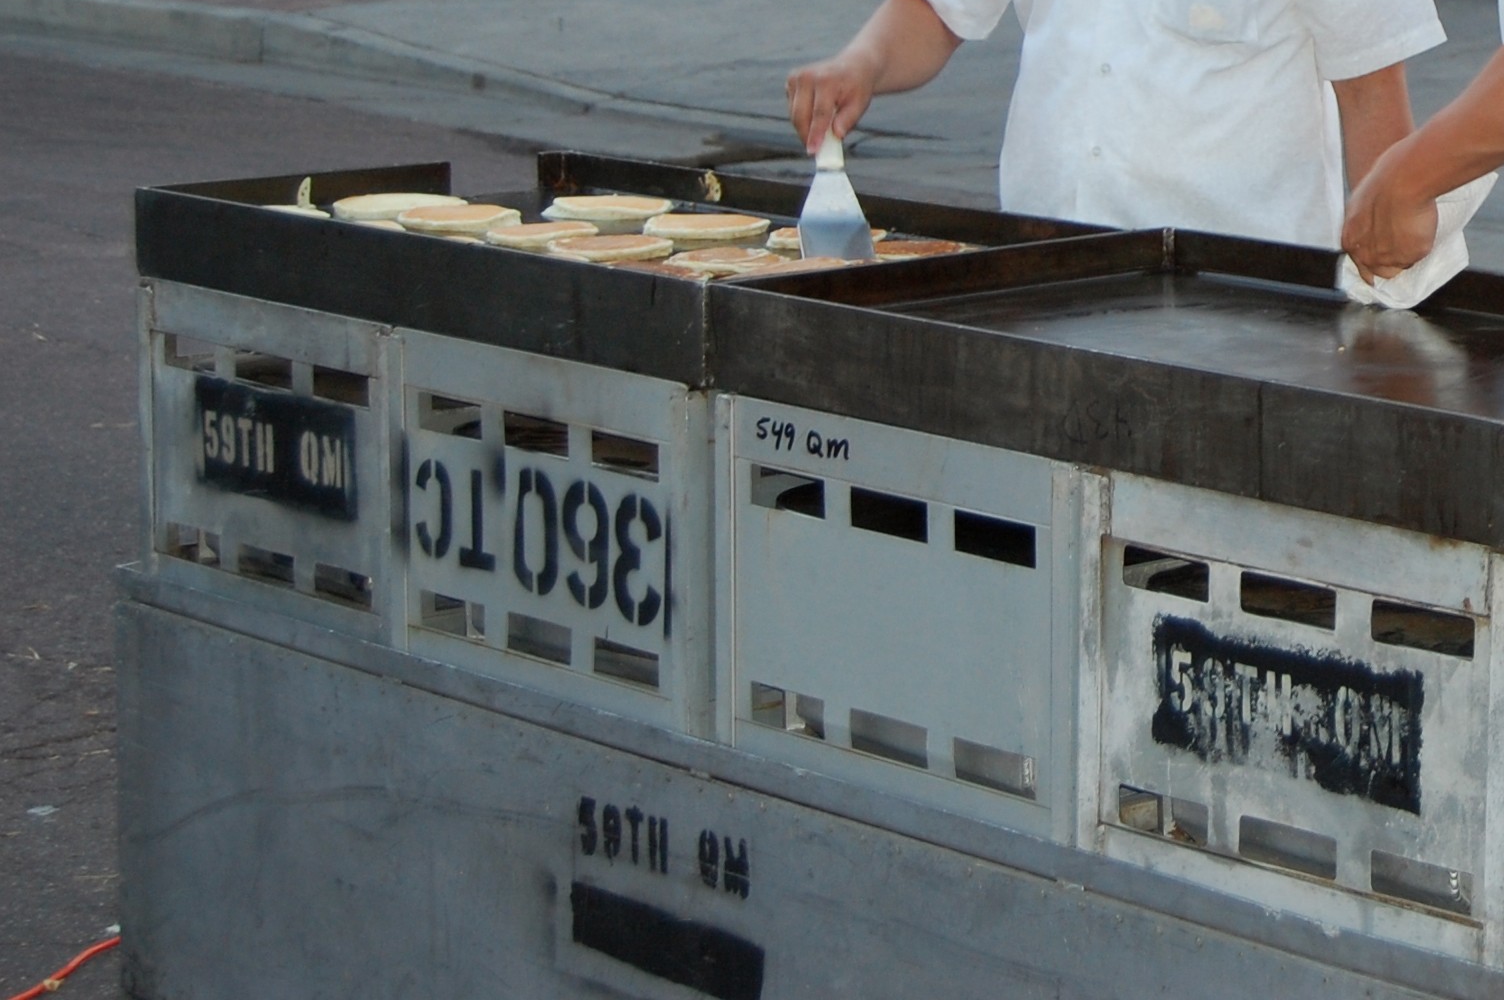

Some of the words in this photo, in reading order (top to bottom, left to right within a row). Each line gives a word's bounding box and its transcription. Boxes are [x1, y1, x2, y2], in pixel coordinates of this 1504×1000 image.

[203, 410, 275, 474] 59TH
[300, 429, 343, 489] QM
[756, 417, 796, 451] 549
[1169, 646, 1293, 737] 59TH
[578, 796, 670, 875] 59TH
